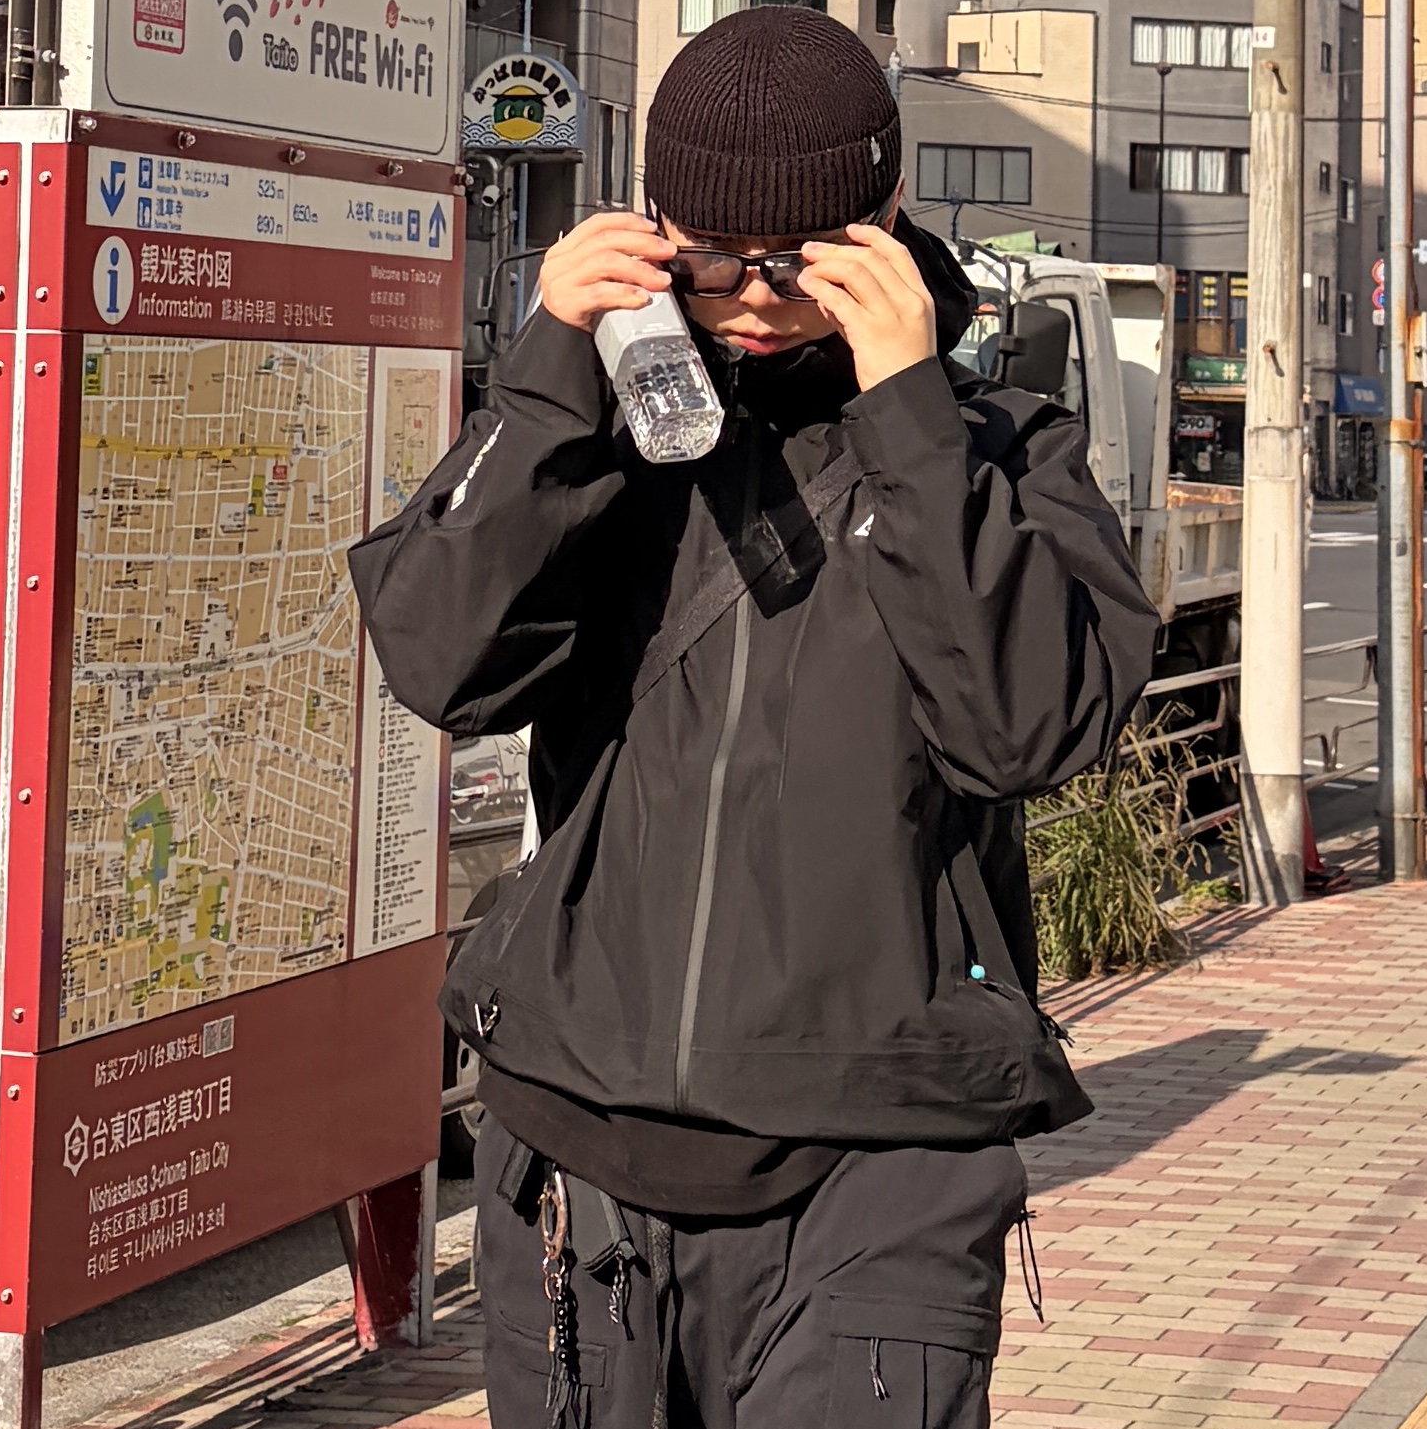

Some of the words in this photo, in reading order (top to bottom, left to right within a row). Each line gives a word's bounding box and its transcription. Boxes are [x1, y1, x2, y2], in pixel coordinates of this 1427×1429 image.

[262, 32, 300, 73] Taito
[310, 19, 368, 85] FREE
[375, 33, 433, 98] Wi-Fi
[140, 242, 233, 290] 観光案内図
[137, 291, 213, 319] Information
[91, 1075, 233, 1161] 台東区西浅草3丁目
[88, 1173, 149, 1215] Nishiasakusa
[149, 1156, 187, 1193] 3-chome
[189, 1147, 211, 1176] Taito
[211, 1140, 231, 1170] City
